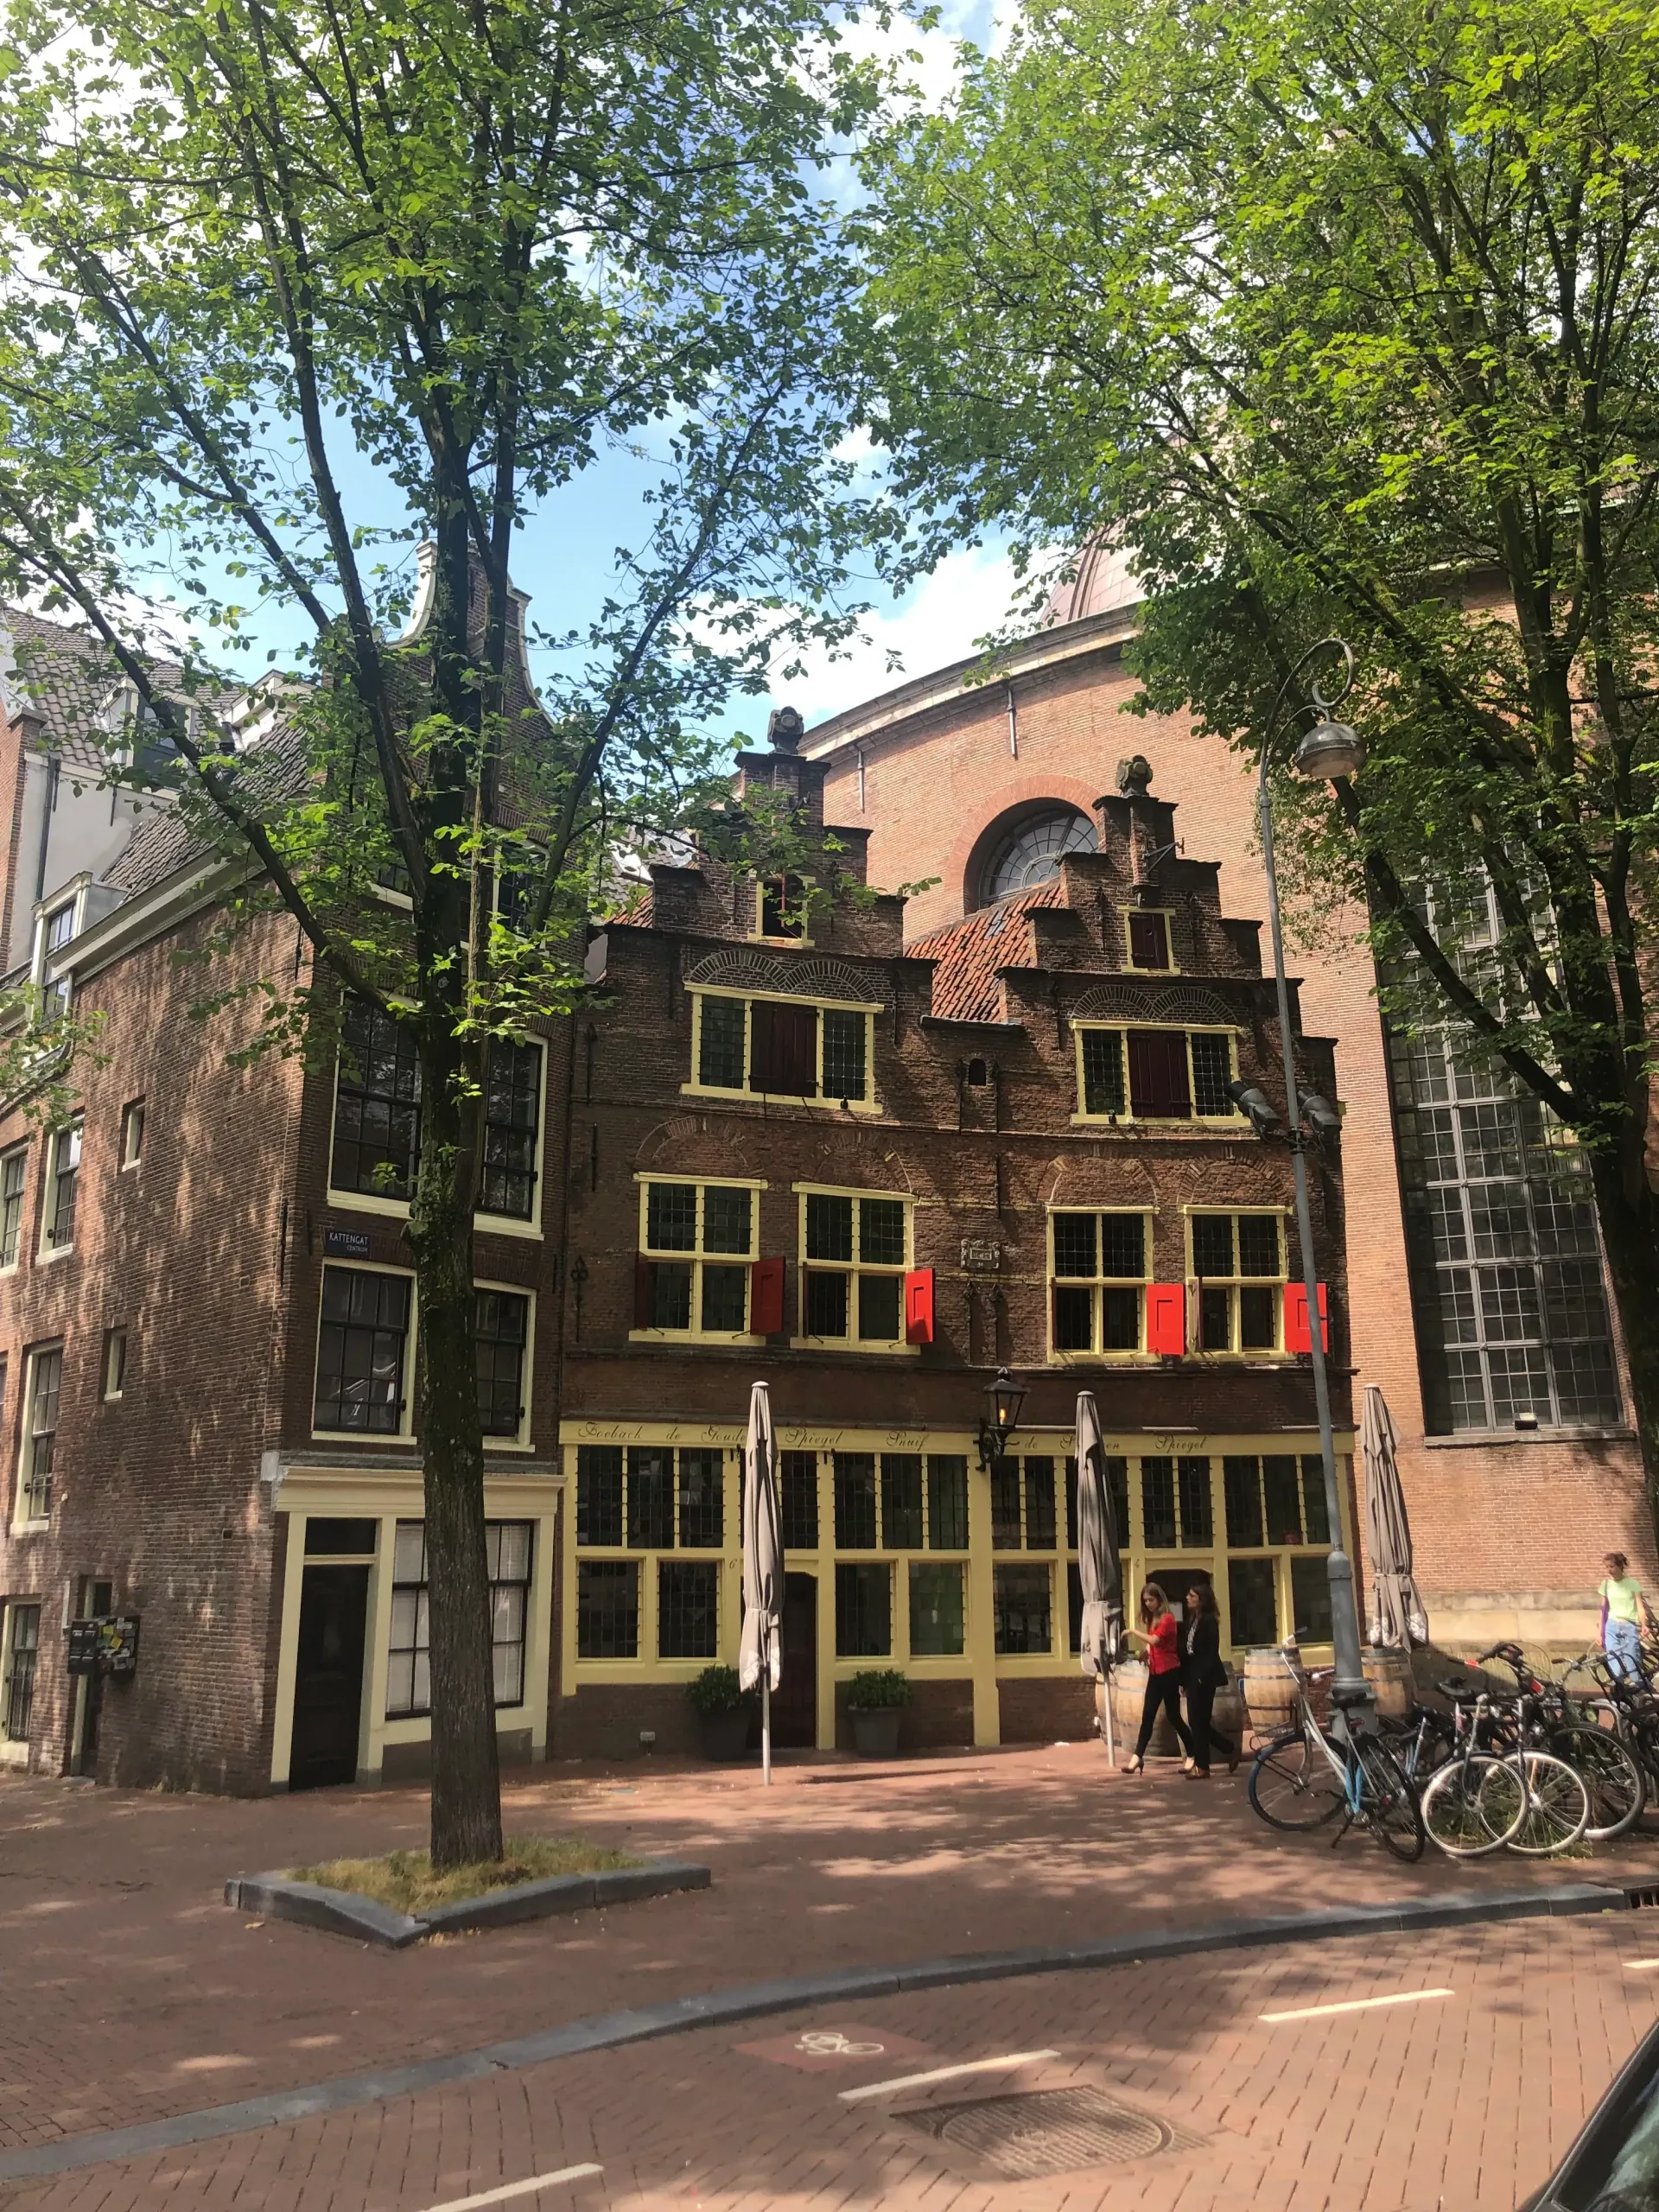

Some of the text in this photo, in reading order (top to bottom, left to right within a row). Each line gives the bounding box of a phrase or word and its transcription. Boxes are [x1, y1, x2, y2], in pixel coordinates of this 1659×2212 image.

[329, 1232, 369, 1245] KATTENGAT
[666, 1427, 681, 1440] de
[701, 1424, 747, 1442] Goude
[785, 1427, 843, 1448] Spiegel
[1024, 1434, 1207, 1454] de Spiegel
